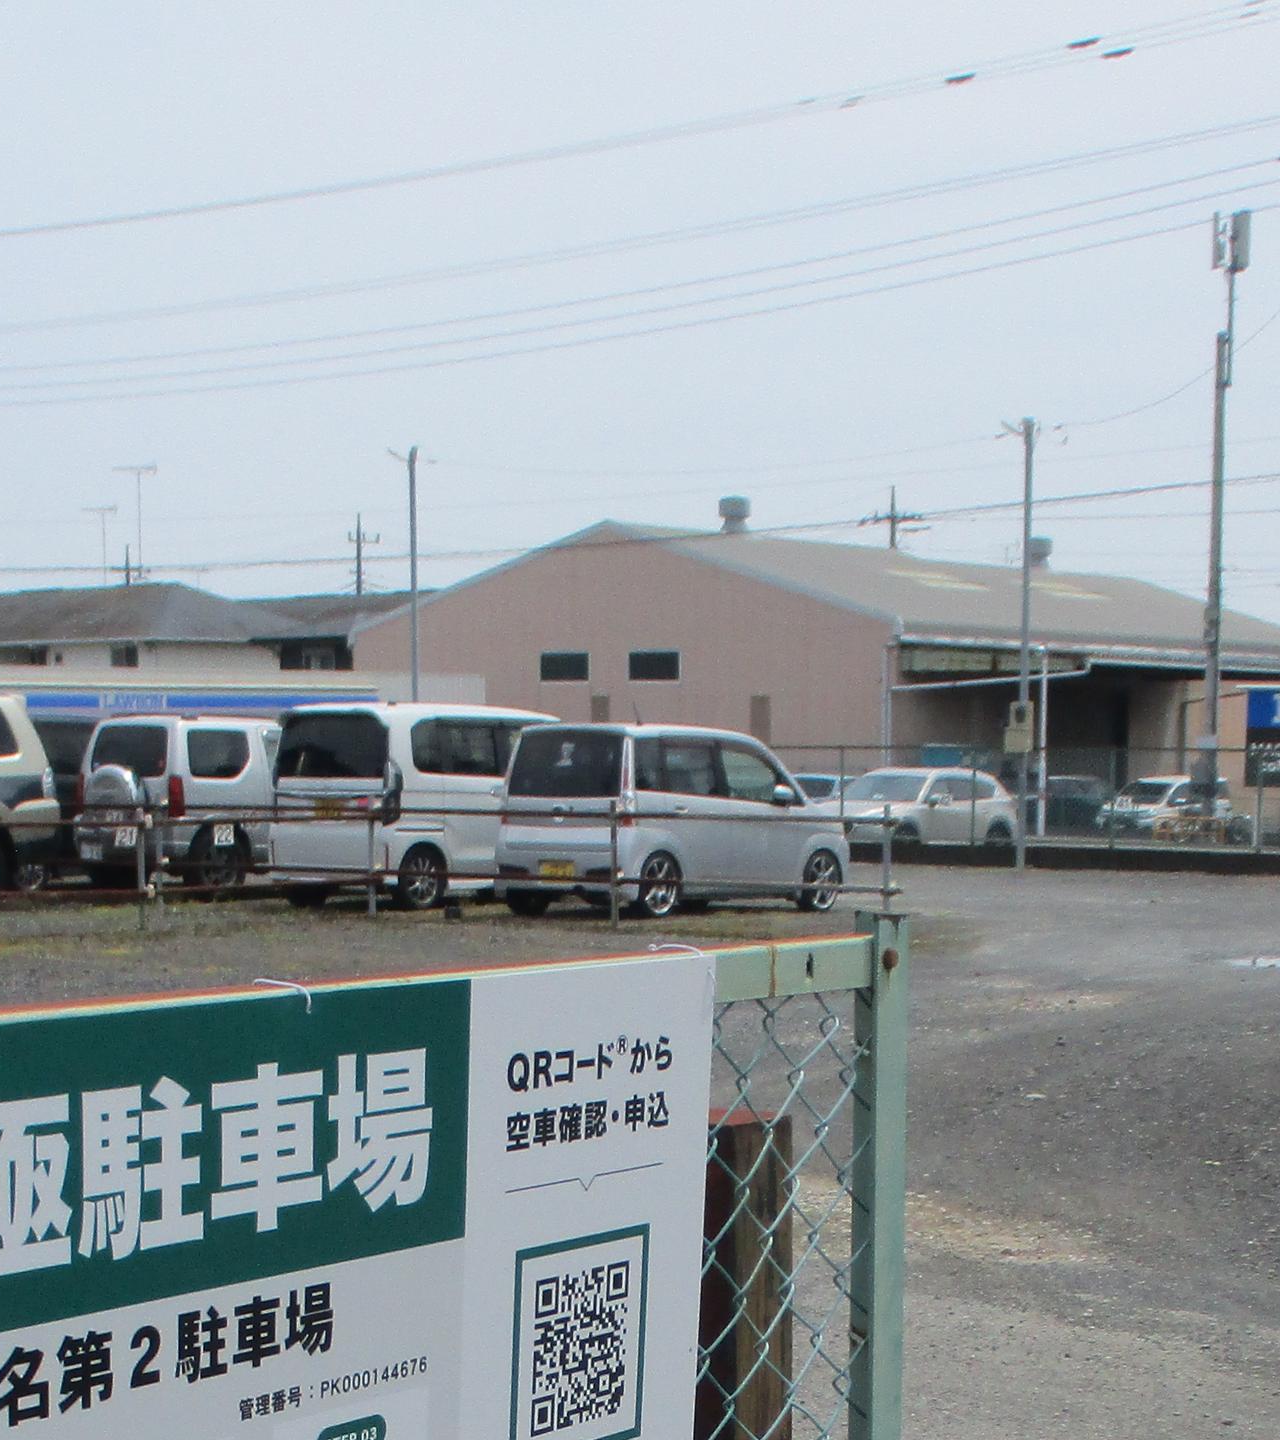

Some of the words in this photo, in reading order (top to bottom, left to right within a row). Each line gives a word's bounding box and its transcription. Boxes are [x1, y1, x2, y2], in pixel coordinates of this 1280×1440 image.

[506, 1090, 670, 1153] 空車確認・申込
